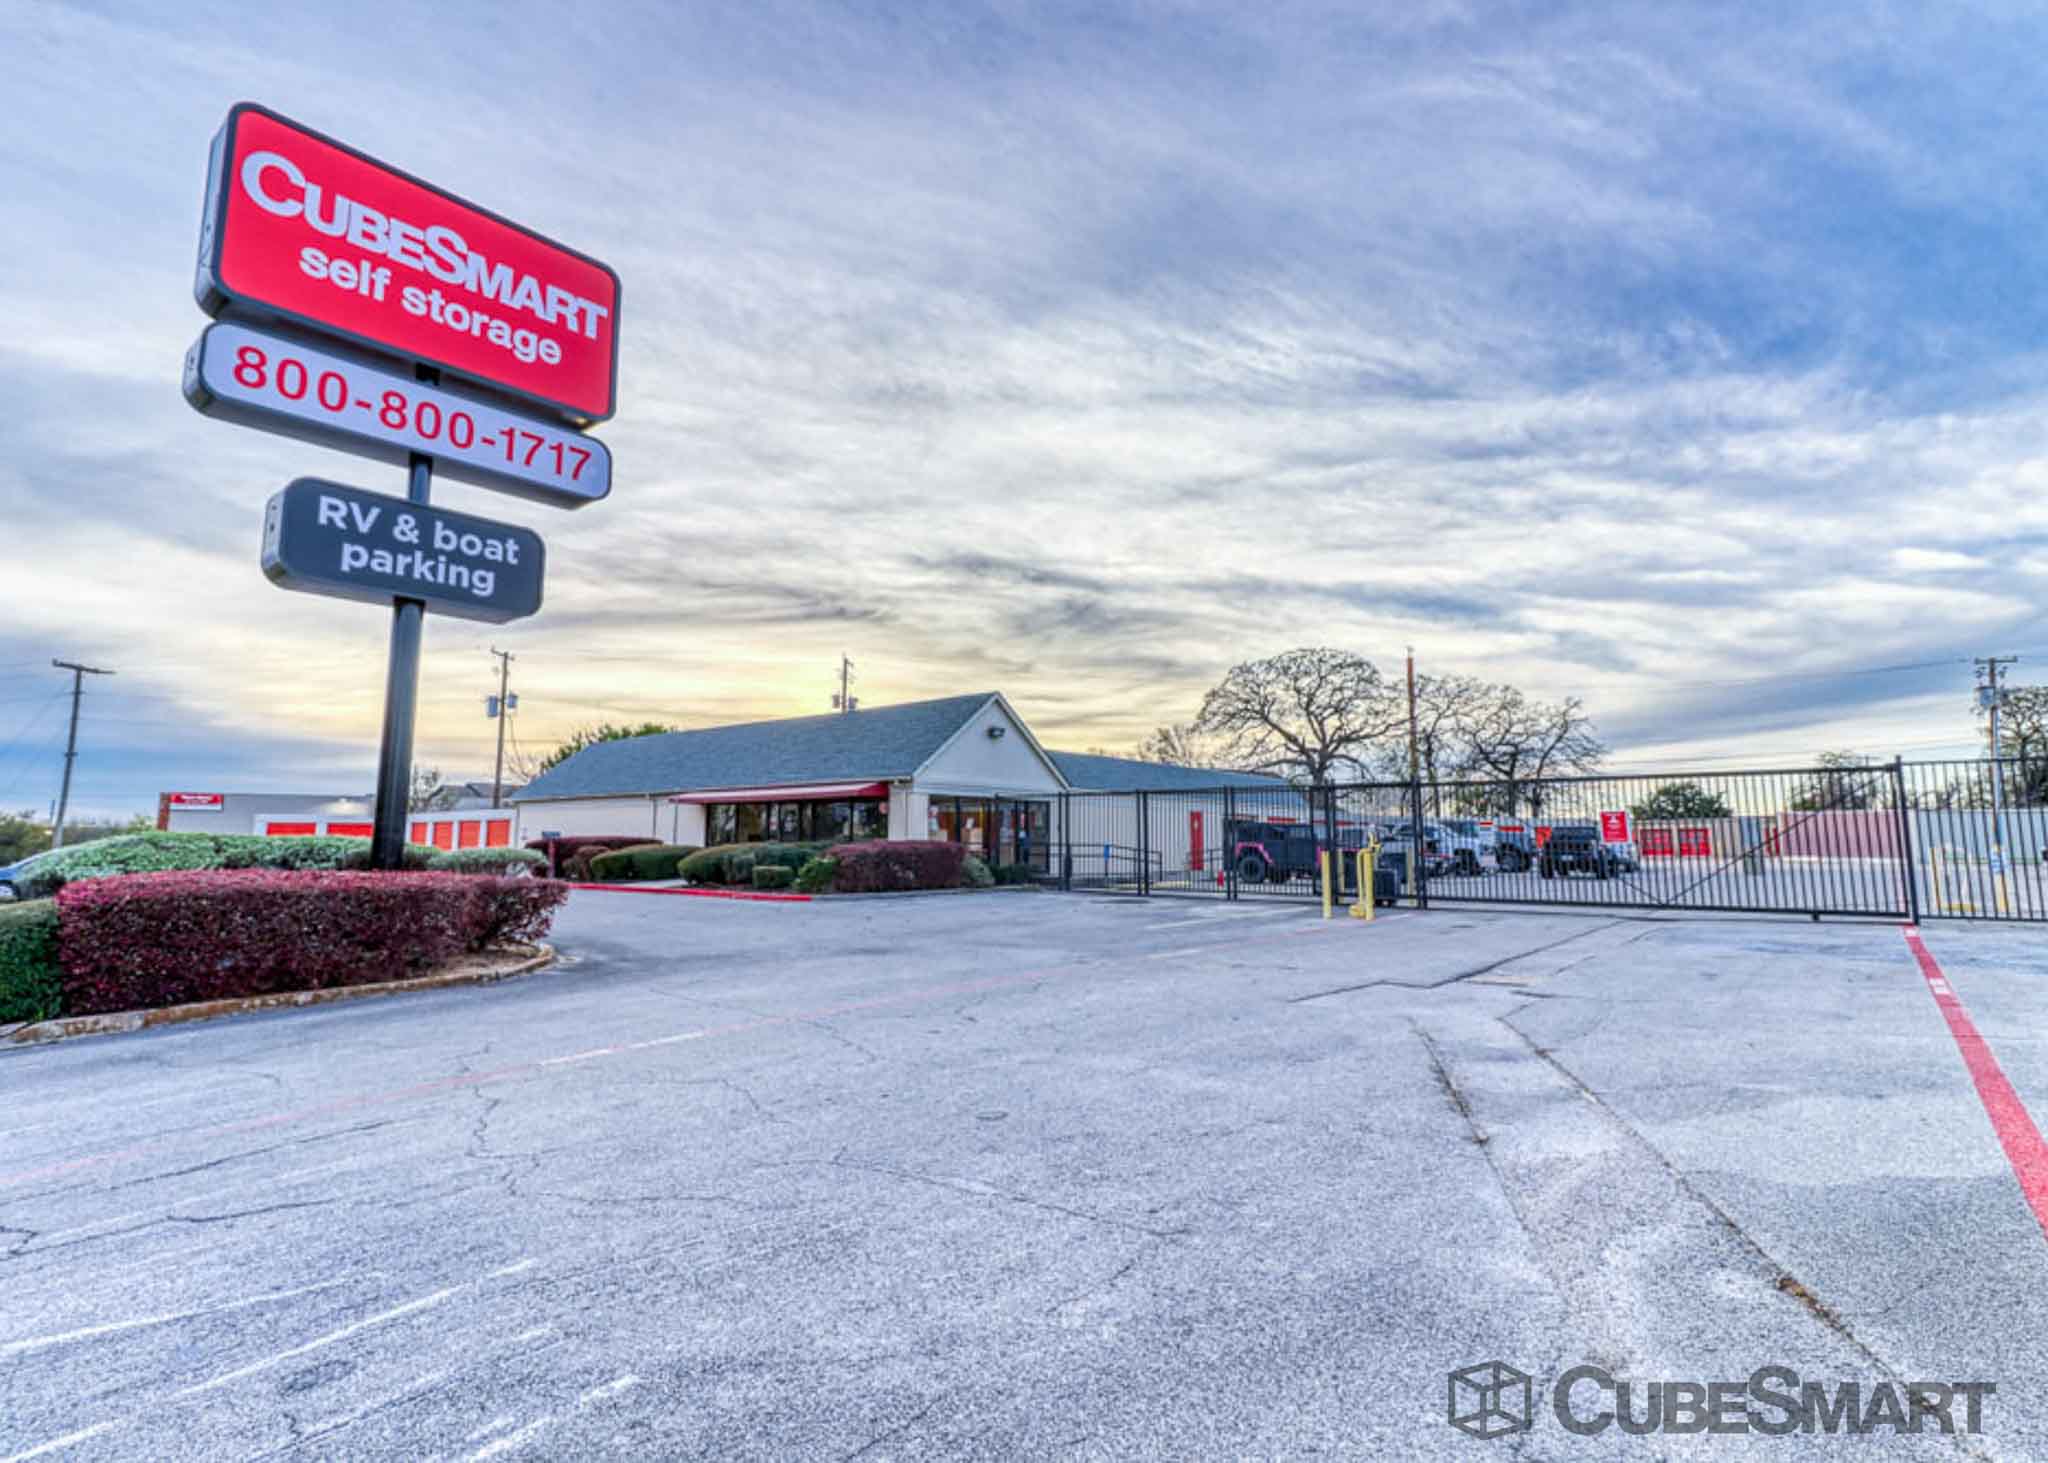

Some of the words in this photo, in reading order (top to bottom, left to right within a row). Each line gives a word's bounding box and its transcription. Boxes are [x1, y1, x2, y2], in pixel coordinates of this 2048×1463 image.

[299, 246, 391, 302] self
[401, 286, 562, 366] storage
[233, 345, 593, 481] 800-800-1717
[318, 496, 381, 535] RV
[393, 514, 421, 545] &
[434, 521, 520, 566] boat
[341, 542, 496, 597] parking
